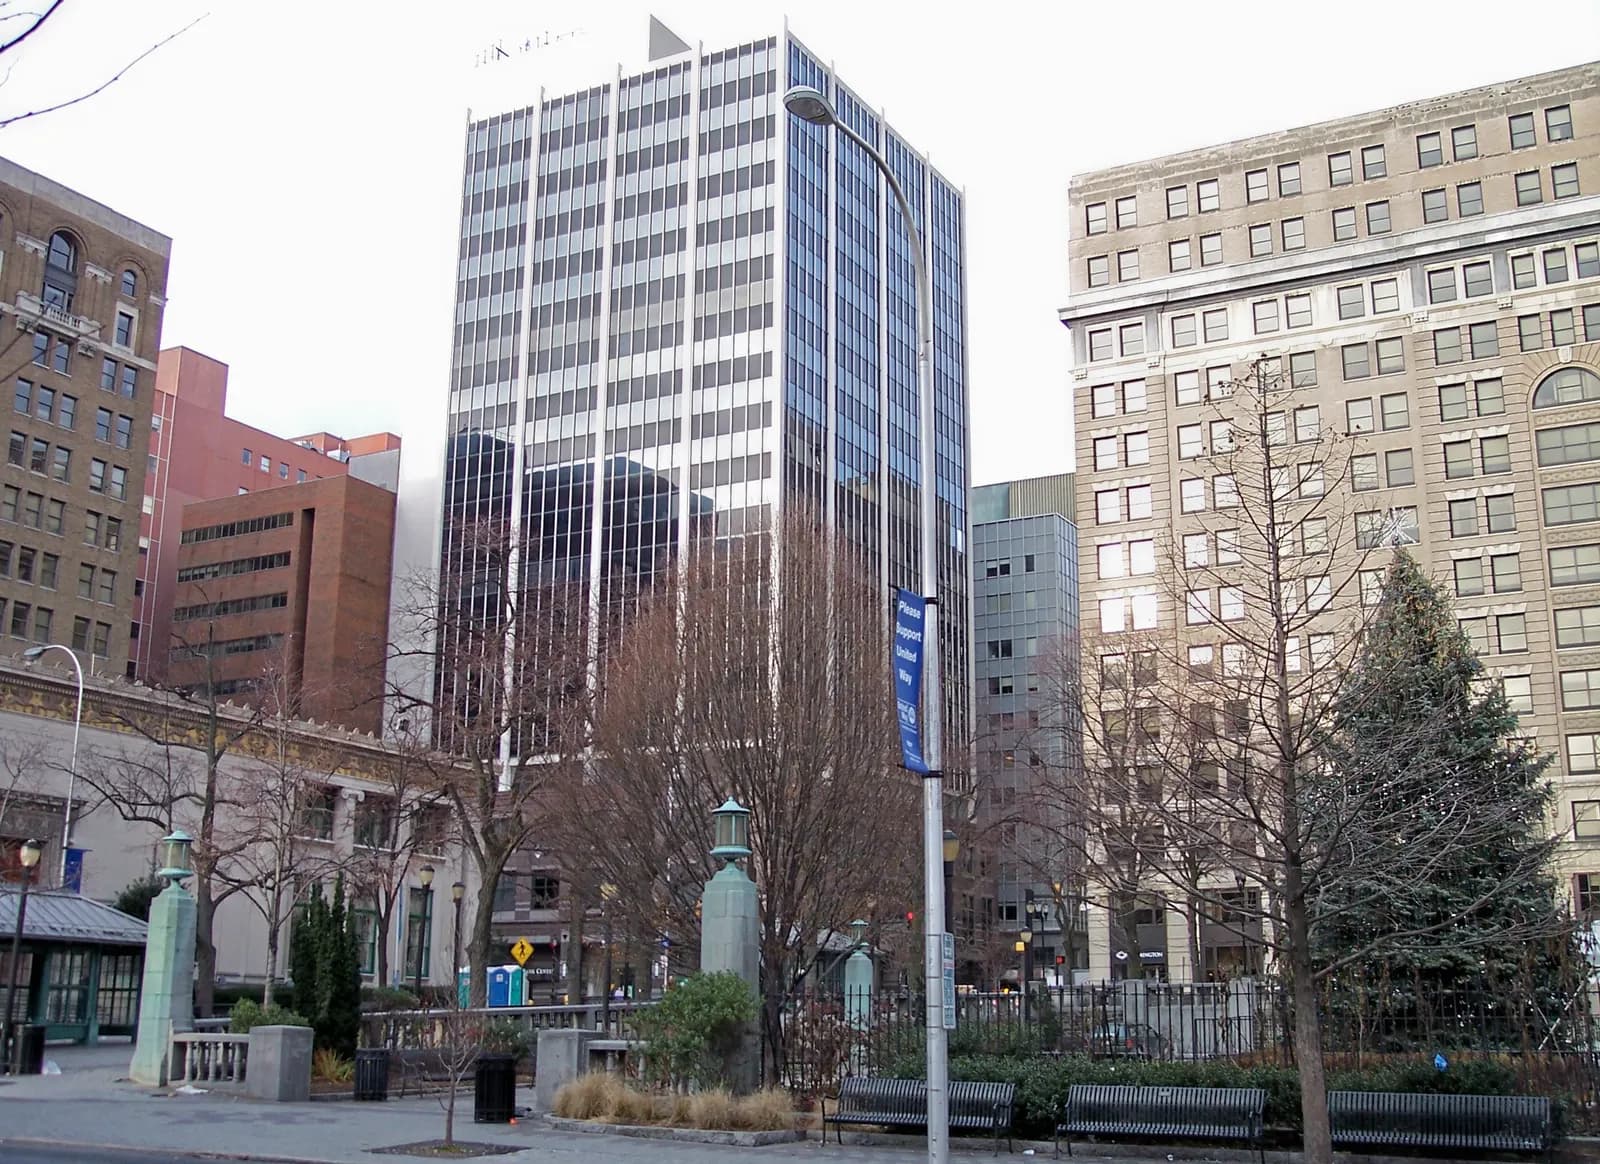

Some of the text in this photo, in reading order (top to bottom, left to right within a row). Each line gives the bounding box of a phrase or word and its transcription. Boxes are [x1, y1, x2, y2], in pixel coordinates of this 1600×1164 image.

[899, 601, 921, 619] Please
[896, 621, 922, 642] Support
[896, 644, 917, 663] United
[898, 667, 912, 686] Way
